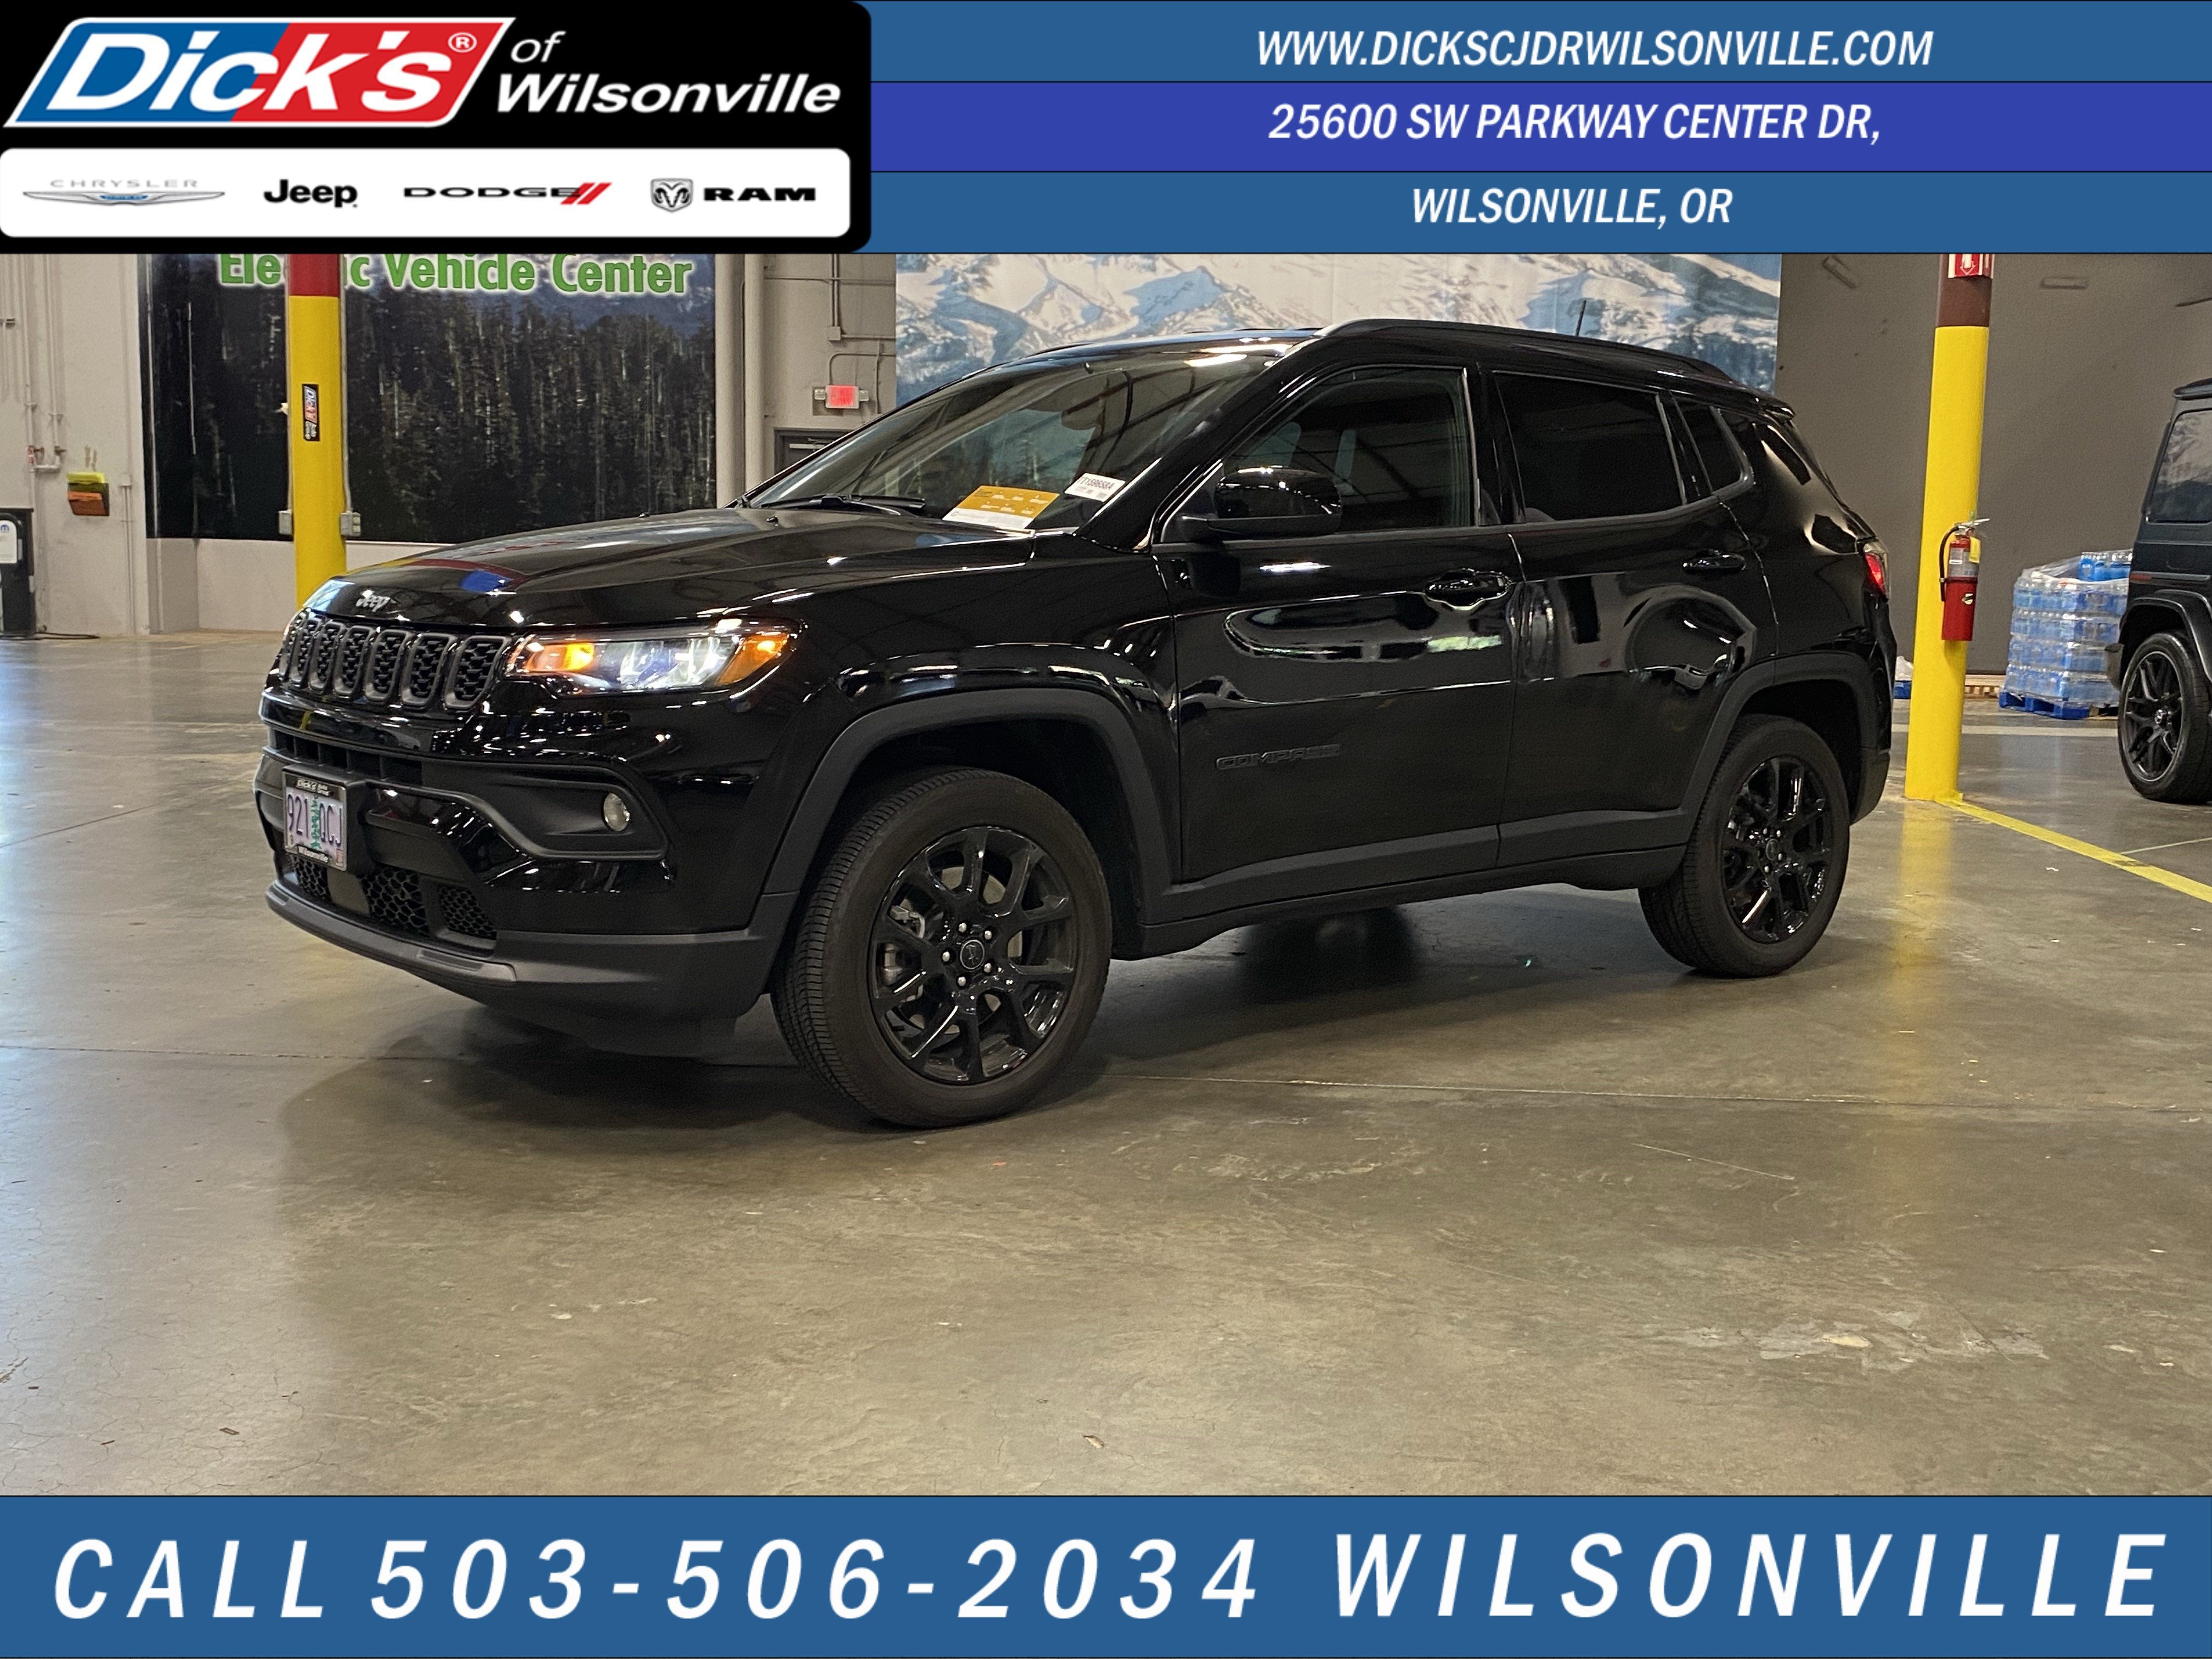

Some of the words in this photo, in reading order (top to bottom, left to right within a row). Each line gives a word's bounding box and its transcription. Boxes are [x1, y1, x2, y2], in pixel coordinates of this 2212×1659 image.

[385, 254, 535, 290] Vehicle
[552, 254, 692, 293] Center
[356, 595, 391, 612] Jeep
[1216, 743, 1340, 770] COMPASS
[287, 794, 309, 839] 921
